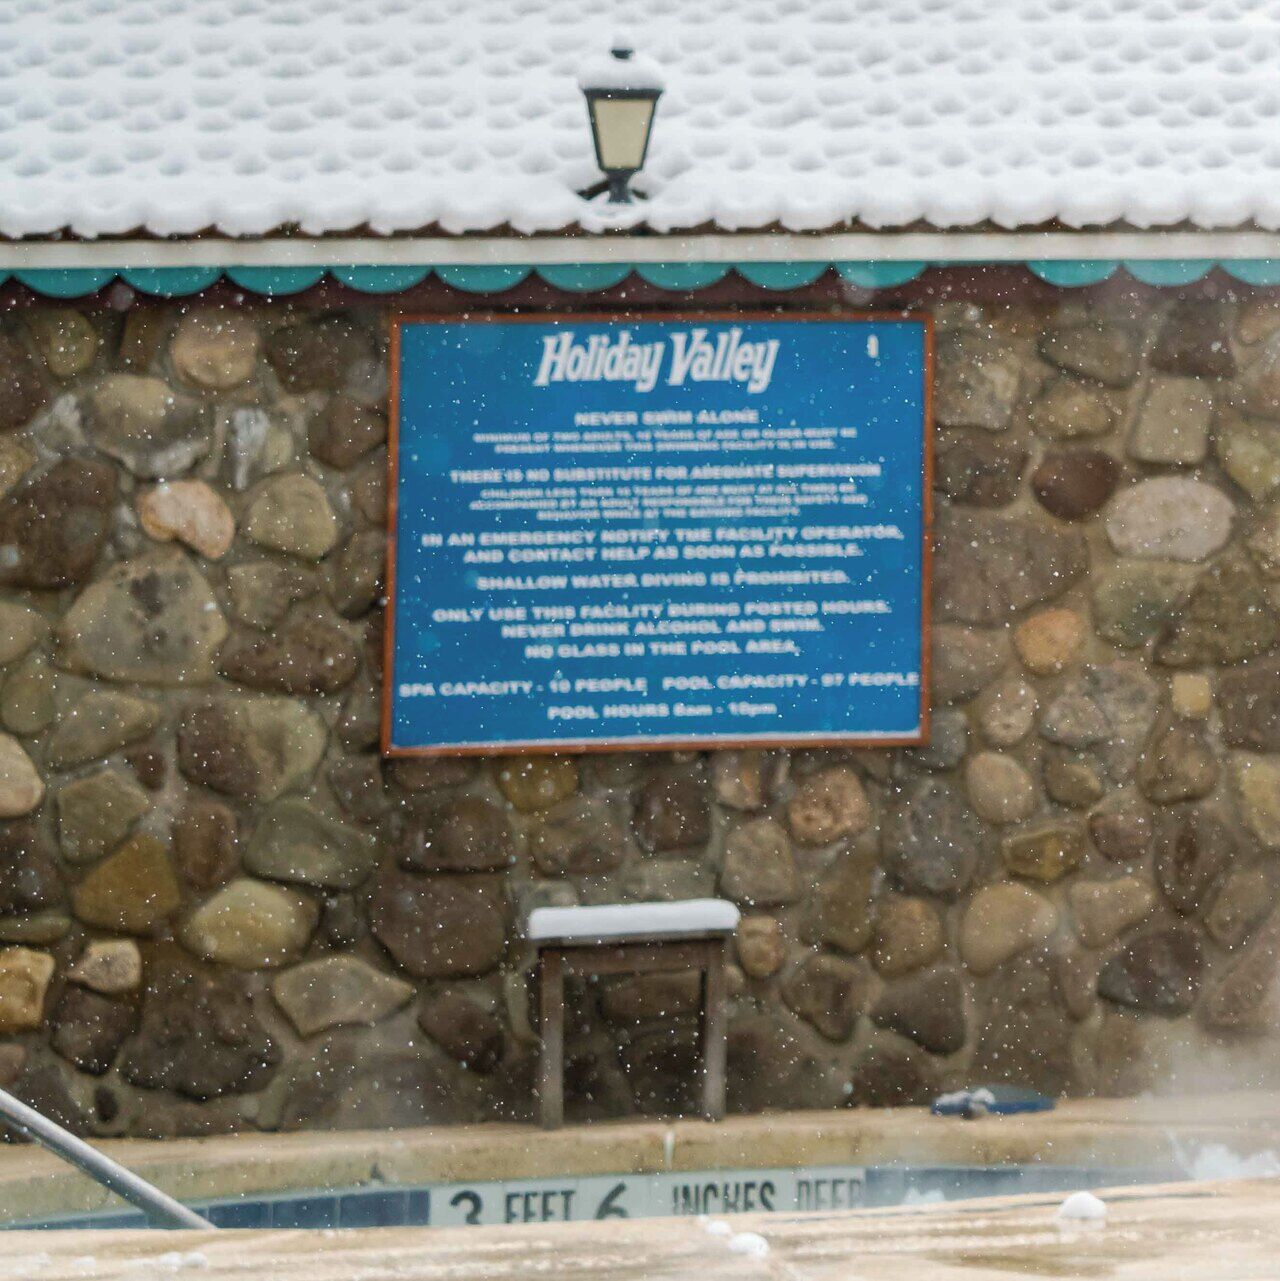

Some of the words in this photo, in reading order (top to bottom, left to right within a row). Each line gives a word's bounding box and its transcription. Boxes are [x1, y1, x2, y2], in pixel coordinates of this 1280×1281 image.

[533, 331, 665, 392] Holiday
[667, 328, 780, 393] Valley
[575, 412, 638, 425] NEVER
[696, 410, 759, 424] ALONE
[553, 467, 652, 482] SUBSTITUTE
[421, 533, 443, 546] IN
[447, 533, 475, 546] AN
[479, 531, 596, 546] EMERGENCY
[601, 529, 670, 543] NOTIFY
[675, 528, 712, 542] THE
[715, 527, 797, 541] FACILITY
[463, 550, 504, 563] AND
[507, 548, 597, 563] CONTACT
[601, 547, 650, 561] HELP
[653, 546, 679, 559] AS
[682, 545, 736, 559] SOON
[739, 544, 765, 558] AS
[476, 576, 568, 589] SHALLOW
[641, 572, 707, 586] DIVING
[710, 572, 730, 585] IS
[432, 608, 484, 622] ONLY
[488, 607, 527, 621] USE
[531, 606, 576, 620] THIS
[580, 604, 664, 618] FACILITY
[667, 602, 741, 617] DURING
[744, 601, 818, 615] POSTED
[501, 624, 565, 638] NEVER
[569, 622, 630, 636] DRINK
[634, 620, 722, 635] ALCOHOL
[725, 619, 767, 633] AND
[525, 644, 554, 658] NO
[557, 643, 620, 657] GLASS
[623, 642, 645, 656] IN
[648, 641, 688, 655] THE
[690, 640, 742, 655] POOL
[399, 683, 436, 697] SPA
[439, 680, 533, 695] CAPACITY
[575, 677, 647, 692] PEOPLE
[662, 676, 713, 690] POOL
[716, 674, 808, 689] CAPACITY
[848, 672, 918, 686] PEOPLE
[547, 705, 599, 720] POOL
[602, 703, 670, 718] HOURS
[504, 1189, 576, 1223] FEET
[595, 1182, 629, 1219] 6
[671, 1180, 777, 1215] INCHES
